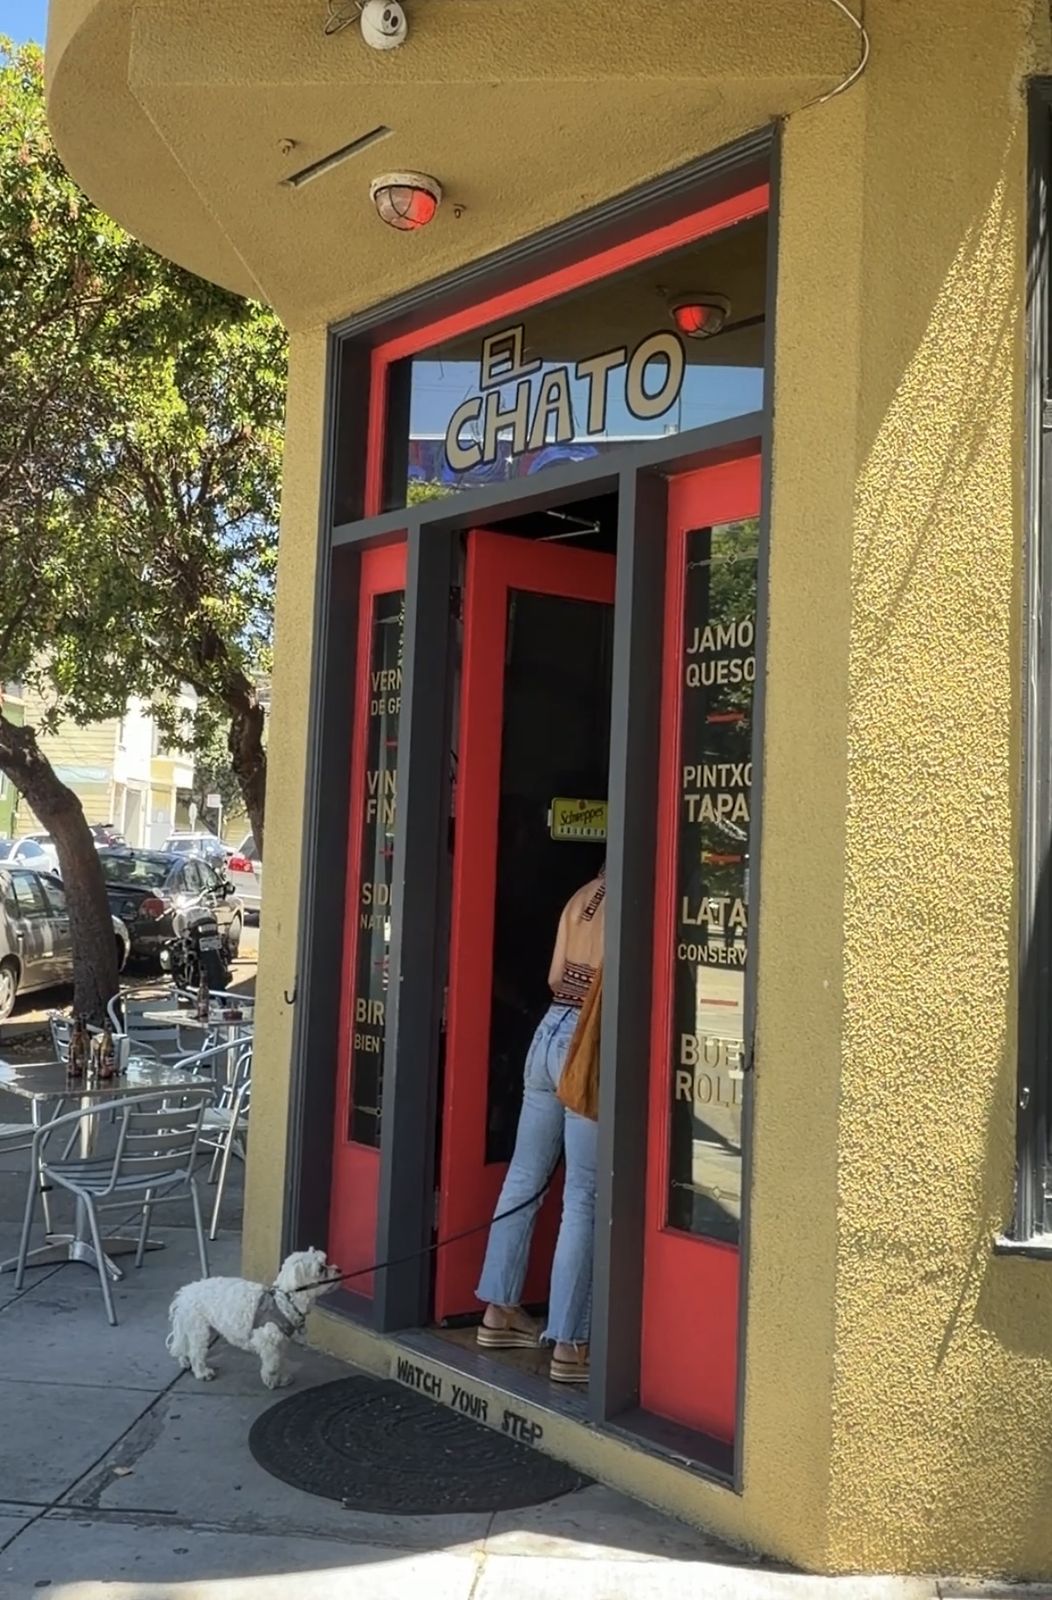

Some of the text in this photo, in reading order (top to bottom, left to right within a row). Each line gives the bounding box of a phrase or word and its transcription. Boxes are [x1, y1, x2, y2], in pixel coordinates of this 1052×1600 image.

[480, 324, 542, 391] EL
[445, 330, 685, 472] CHATO
[686, 656, 756, 687] QUESO
[370, 699, 385, 716] DE
[684, 794, 749, 822] TAPA
[682, 897, 747, 926] LATA
[677, 944, 748, 965] CONSERV
[354, 1033, 380, 1053] BIEN
[397, 1356, 544, 1445] WATCH YOUR STEP
